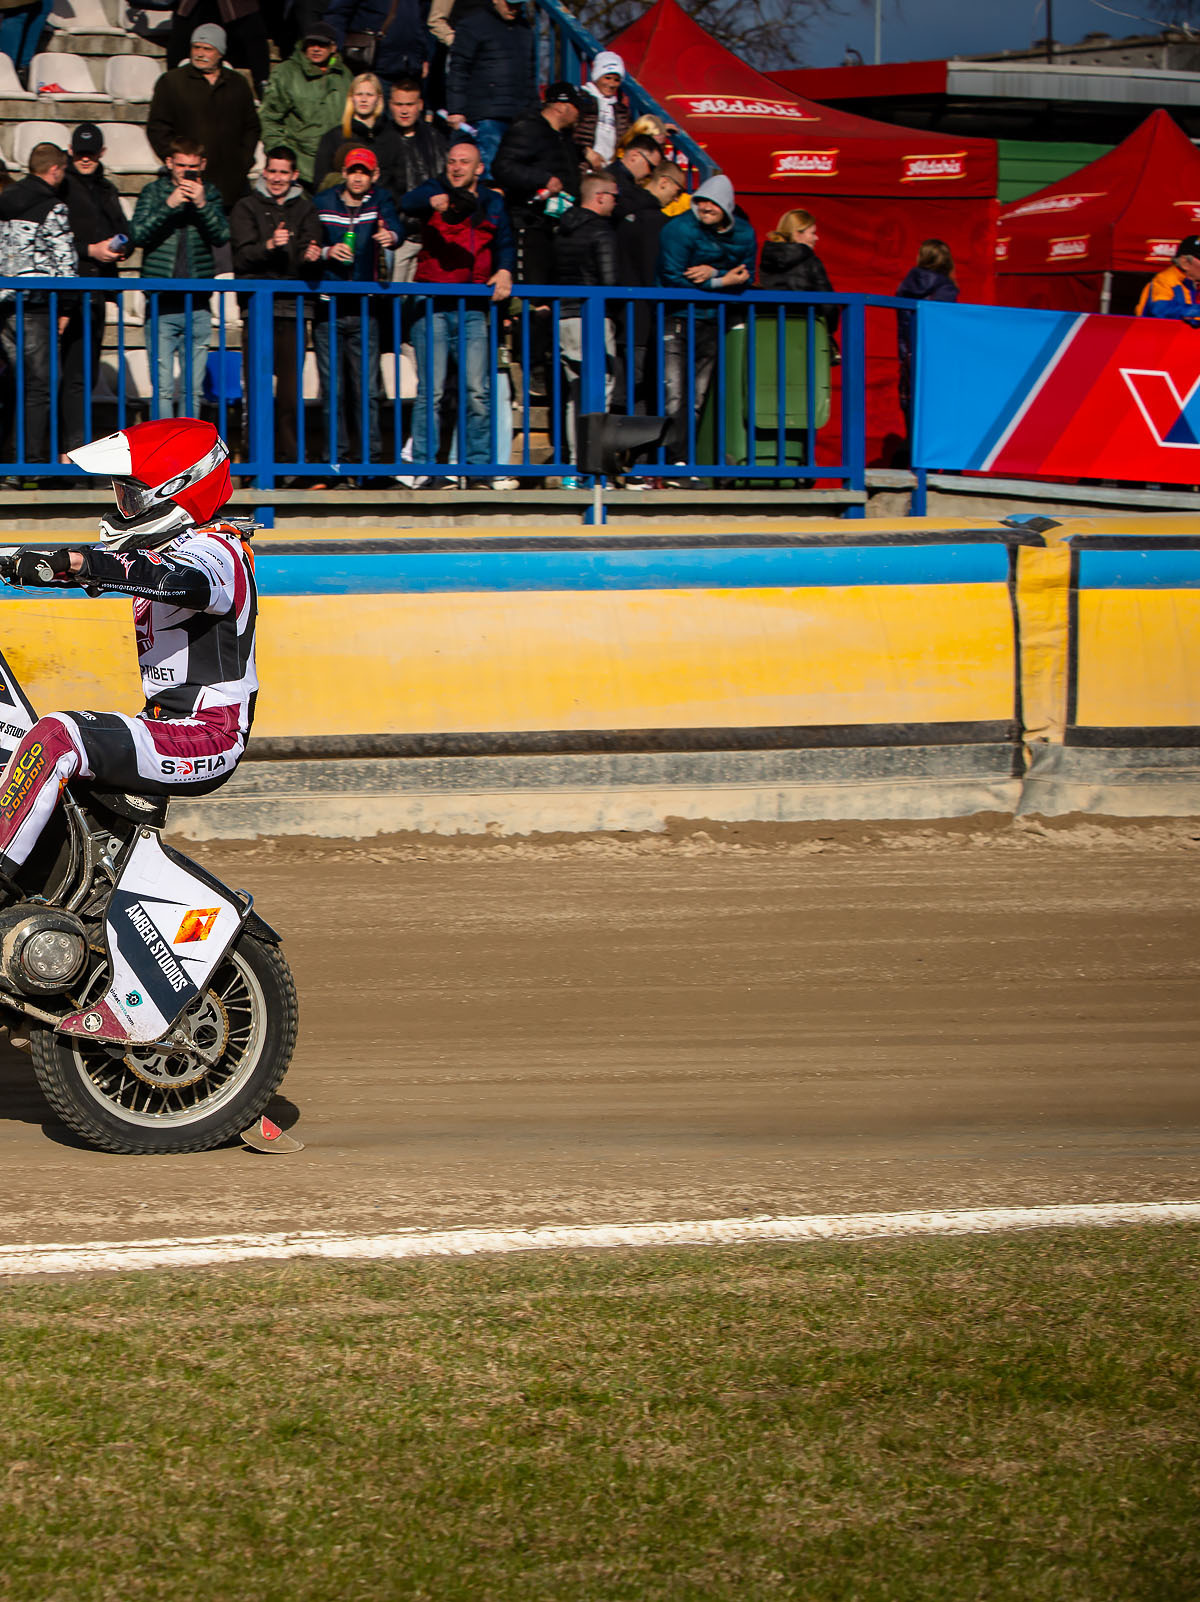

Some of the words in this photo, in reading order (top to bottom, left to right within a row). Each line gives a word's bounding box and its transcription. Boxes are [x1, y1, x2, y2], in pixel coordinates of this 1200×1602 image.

[140, 664, 175, 681] PTIBET
[4, 724, 27, 739] STUDI
[161, 755, 226, 775] SOFIA
[5, 757, 45, 820] LONDON
[124, 903, 159, 946] AMBER
[149, 940, 189, 993] STUDIOS
